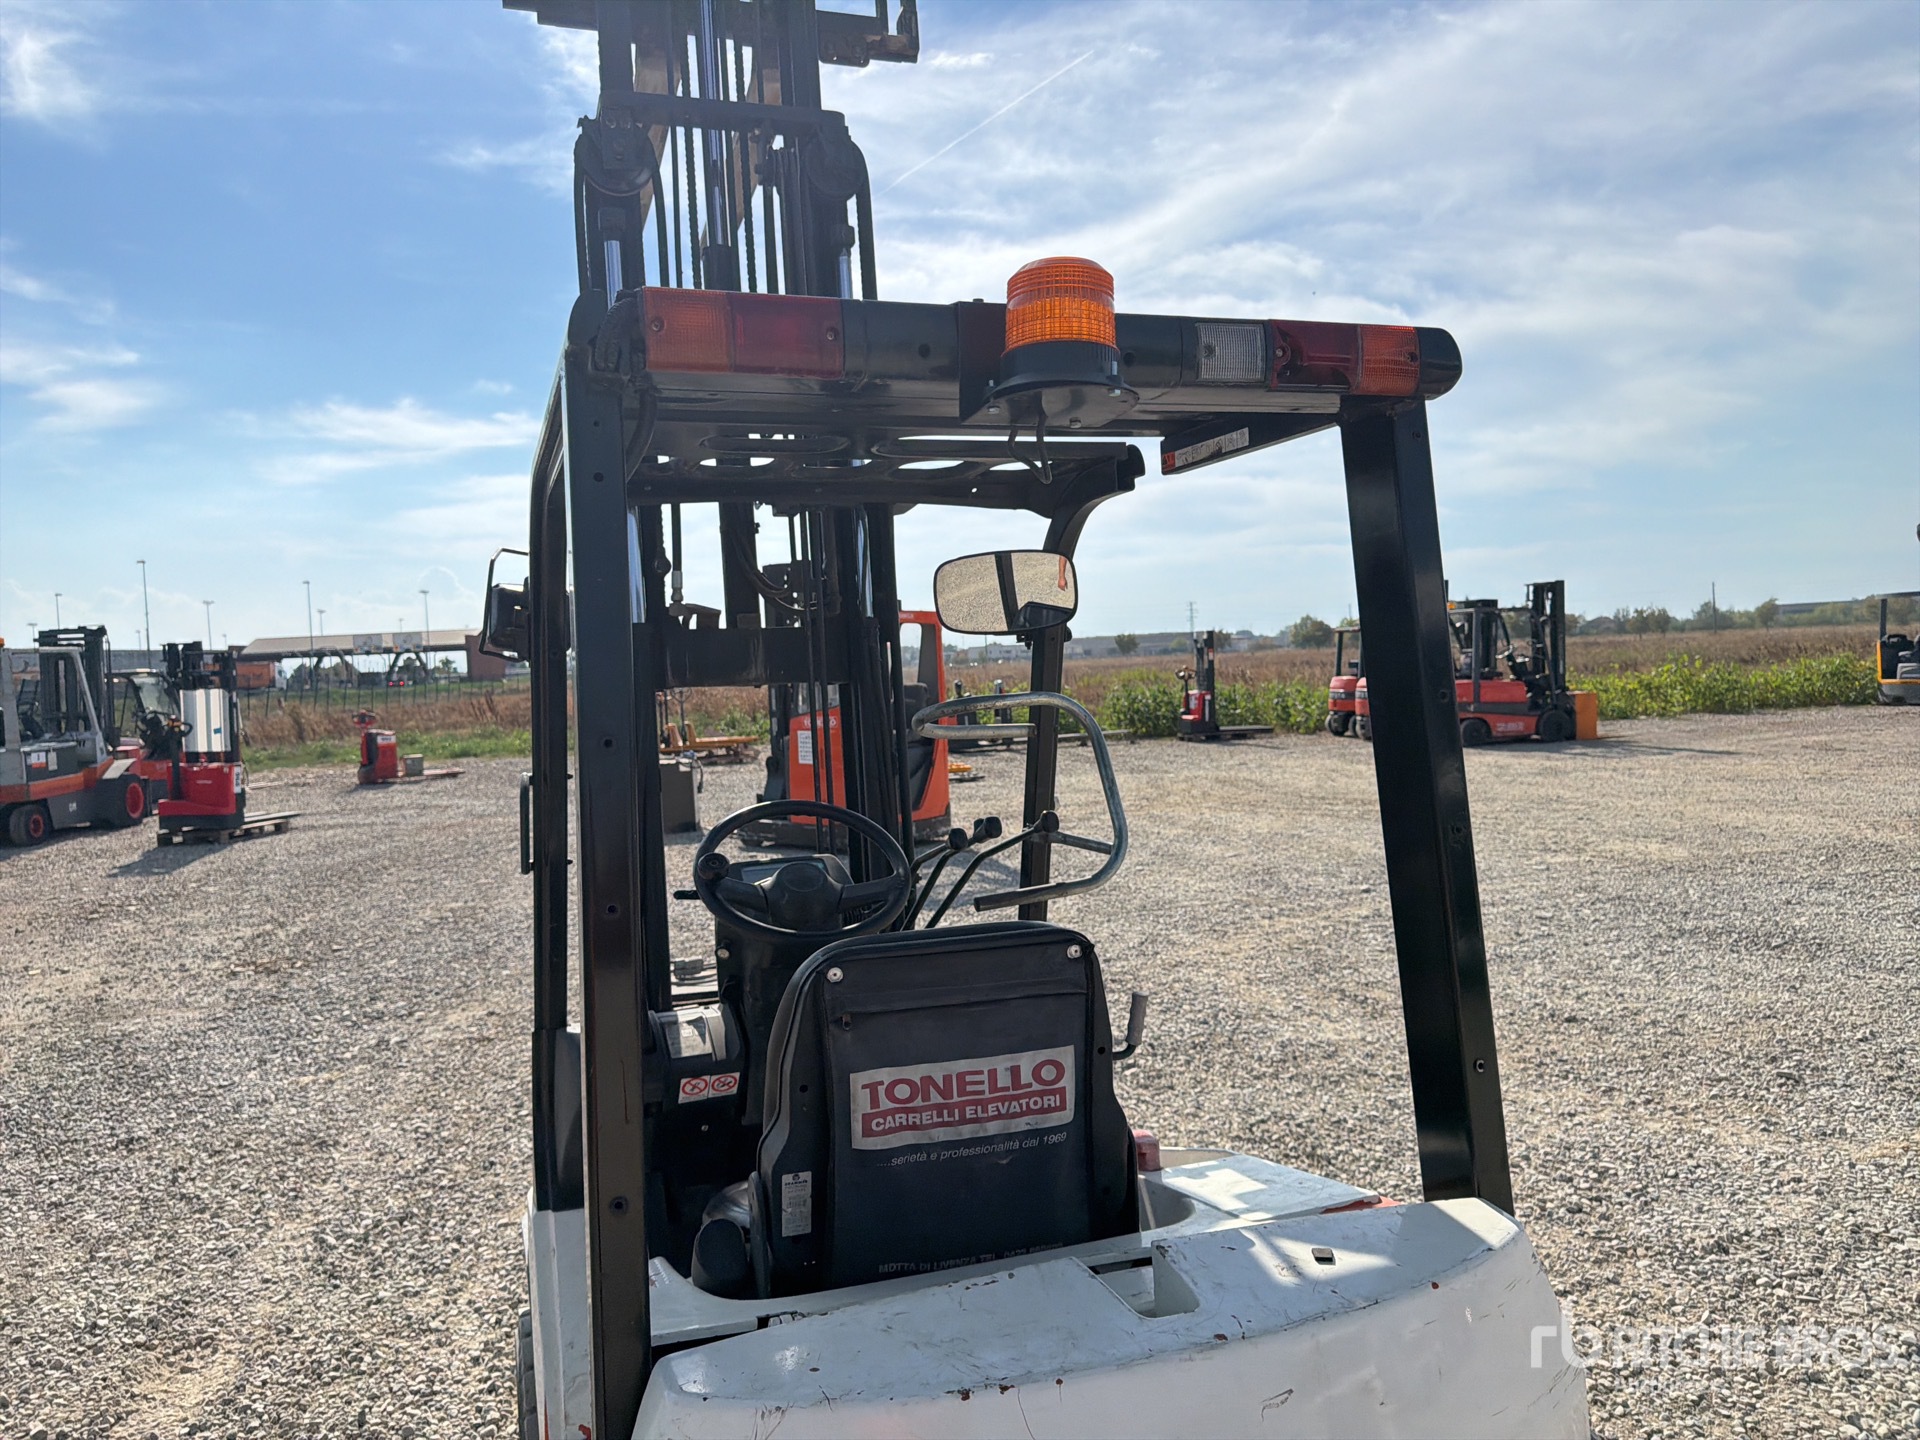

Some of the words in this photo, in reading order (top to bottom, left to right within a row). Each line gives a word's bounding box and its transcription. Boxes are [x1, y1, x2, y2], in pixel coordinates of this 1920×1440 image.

[861, 1059, 1066, 1110] TONELLO
[871, 1109, 959, 1132] CARRELLI
[966, 1094, 1061, 1119] ELEVATORI
[930, 1153, 937, 1161] e
[940, 1139, 1019, 1161] professionalità
[1023, 1137, 1039, 1149] dal
[1043, 1132, 1067, 1144] 1969
